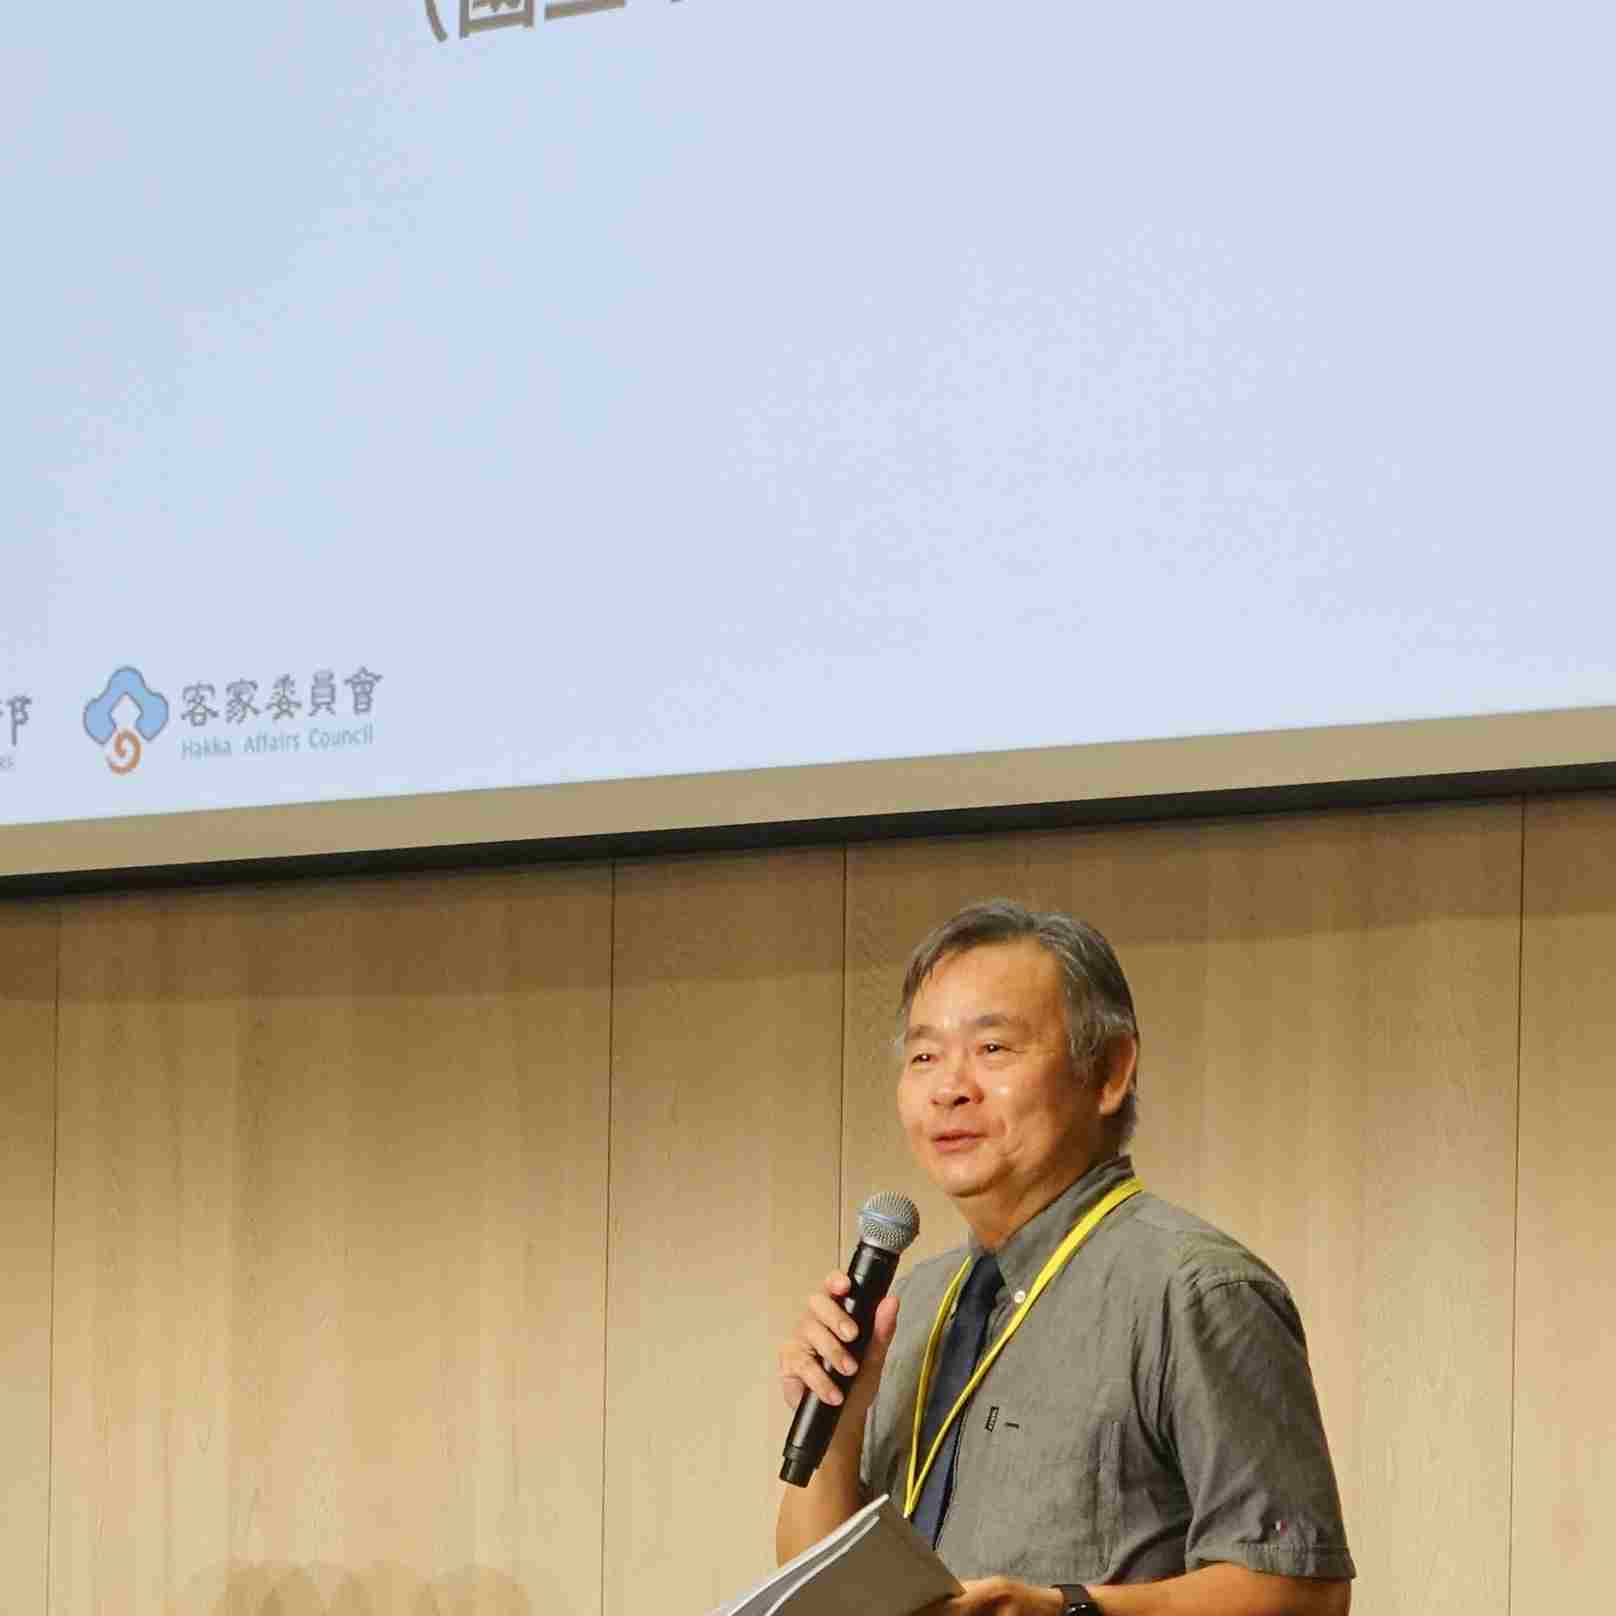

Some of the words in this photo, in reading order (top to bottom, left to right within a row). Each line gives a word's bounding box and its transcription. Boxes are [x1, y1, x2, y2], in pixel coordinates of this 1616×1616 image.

[181, 666, 383, 726] 客家委員會
[182, 737, 232, 760] Hakka
[244, 730, 301, 754] Affairs
[308, 723, 374, 749] Council
